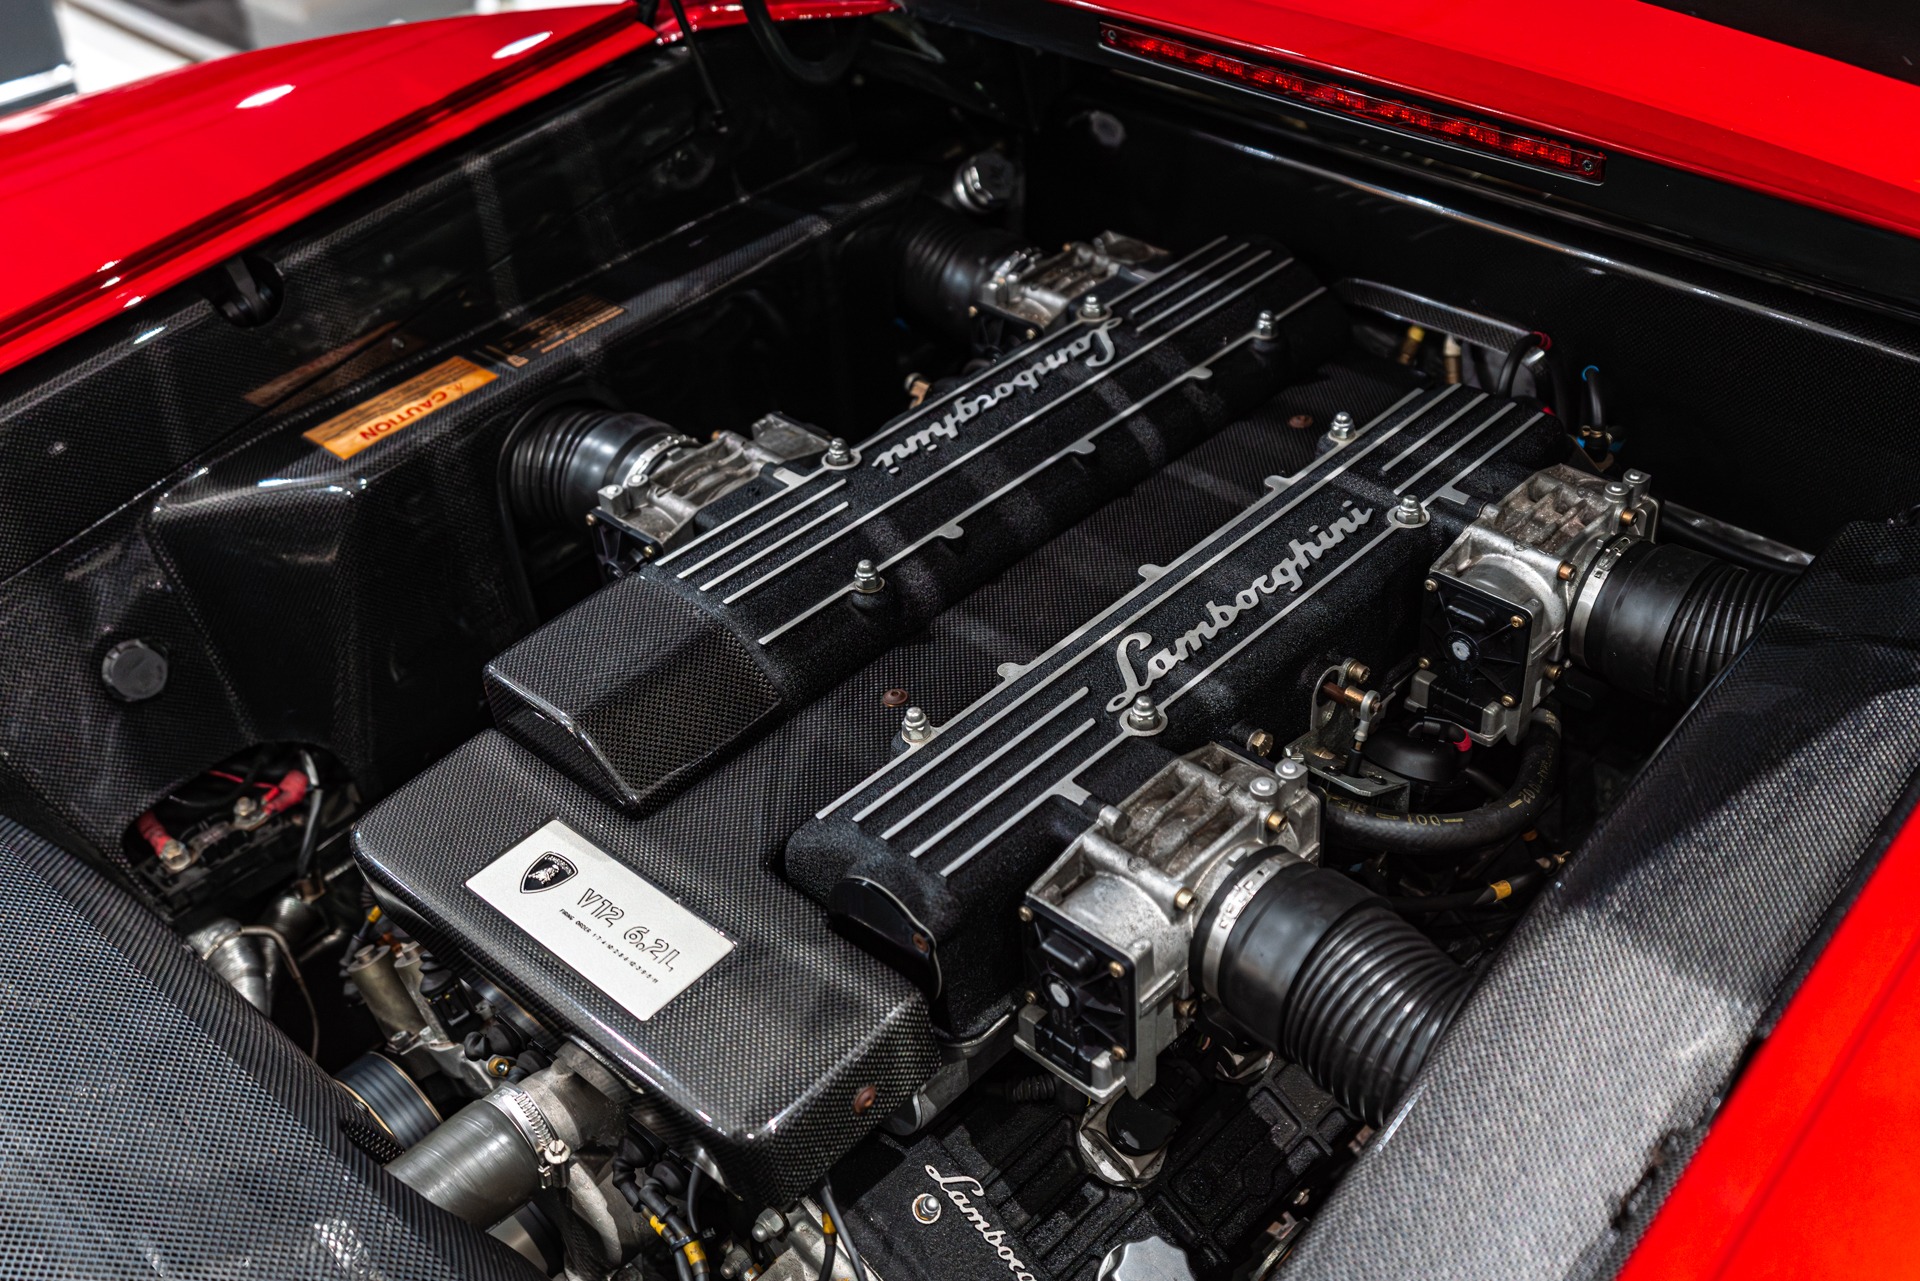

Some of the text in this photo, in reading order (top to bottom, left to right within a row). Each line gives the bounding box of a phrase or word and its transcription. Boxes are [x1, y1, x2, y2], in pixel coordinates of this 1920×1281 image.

[360, 391, 447, 440] CAUTION
[872, 317, 1123, 474] Lamborghini
[1106, 501, 1373, 713] Lamborghini
[575, 920, 592, 933] ORDER
[577, 887, 681, 973] V12 6.2L
